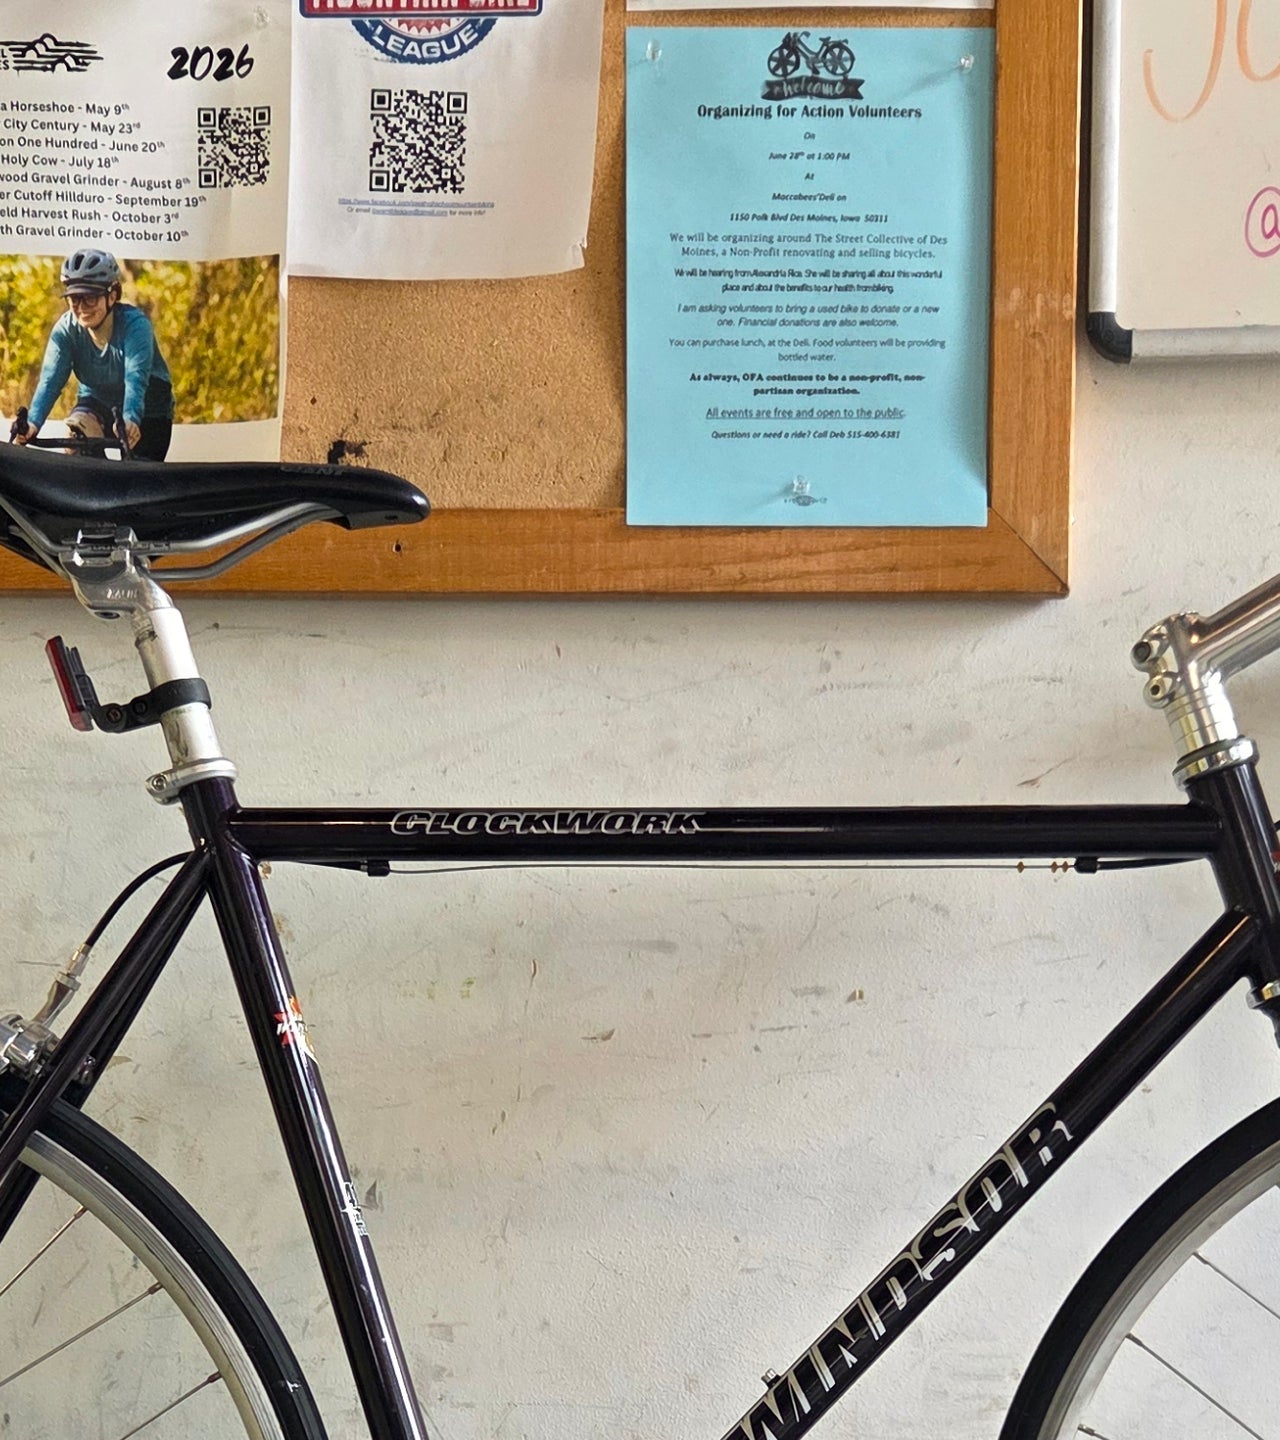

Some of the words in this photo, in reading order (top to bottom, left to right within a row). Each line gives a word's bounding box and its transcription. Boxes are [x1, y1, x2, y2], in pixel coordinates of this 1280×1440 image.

[371, 23, 479, 60] LEAGUE
[167, 44, 255, 82] 2026
[10, 102, 74, 114] Horseshoe
[85, 103, 110, 118] May
[114, 104, 131, 116] 9th
[696, 105, 772, 121] Organizing
[776, 105, 796, 117] for
[801, 105, 844, 118] Action
[848, 105, 923, 118] Volunteers
[3, 119, 27, 133] City
[30, 119, 79, 135] Century
[90, 121, 114, 136] May
[118, 122, 141, 134] 23rd
[17, 136, 42, 148] One
[44, 137, 98, 150] Hundred
[111, 139, 138, 151] June
[141, 140, 166, 152] 20th
[0, 154, 28, 169] Holy
[31, 155, 58, 167] Cow
[68, 156, 93, 171] July
[97, 157, 120, 169] 18th
[31, 173, 70, 185] Gravel
[73, 174, 118, 187] Grinder
[130, 176, 171, 191] August
[175, 177, 191, 189] 8th
[13, 189, 52, 201] Cutoff
[55, 190, 104, 203] Hillduro
[115, 192, 181, 209] September
[184, 195, 207, 207] 19th
[21, 207, 67, 220] Harvest
[71, 209, 100, 221] Rush
[112, 210, 160, 223] October
[164, 212, 180, 224] 3rd
[15, 225, 54, 237] Gravel
[57, 226, 102, 239] Grinder
[114, 228, 162, 240] October
[166, 229, 189, 241] 10th
[670, 233, 684, 243] We
[686, 233, 704, 243] will
[706, 233, 718, 243] be
[721, 233, 774, 246] organizing
[776, 234, 811, 244] around
[815, 234, 832, 244] The
[835, 234, 863, 244] Street
[866, 234, 914, 244] Collective
[916, 235, 926, 244] of
[929, 235, 949, 244] Des
[681, 247, 718, 259] Moines,
[721, 249, 726, 257] a
[729, 247, 779, 257] Non-Profit
[782, 247, 835, 260] renovating
[837, 247, 856, 257] and
[858, 248, 890, 260] selling
[893, 248, 936, 260] bicycles.
[689, 373, 701, 381] As
[702, 373, 740, 384] always,
[742, 373, 763, 381] OFA
[765, 373, 813, 382] continues
[814, 373, 825, 382] to
[827, 373, 838, 382] be
[848, 373, 901, 384] non-profit,
[753, 386, 793, 397] partisan
[795, 386, 861, 397] organization.
[705, 407, 718, 417] All
[720, 407, 753, 417] events
[755, 409, 771, 417] are
[773, 407, 793, 417] free
[795, 407, 814, 417] and
[815, 409, 841, 420] open
[843, 407, 853, 418] to
[855, 407, 872, 418] the
[873, 407, 906, 420] public.
[391, 810, 707, 835] CLOCKWORK
